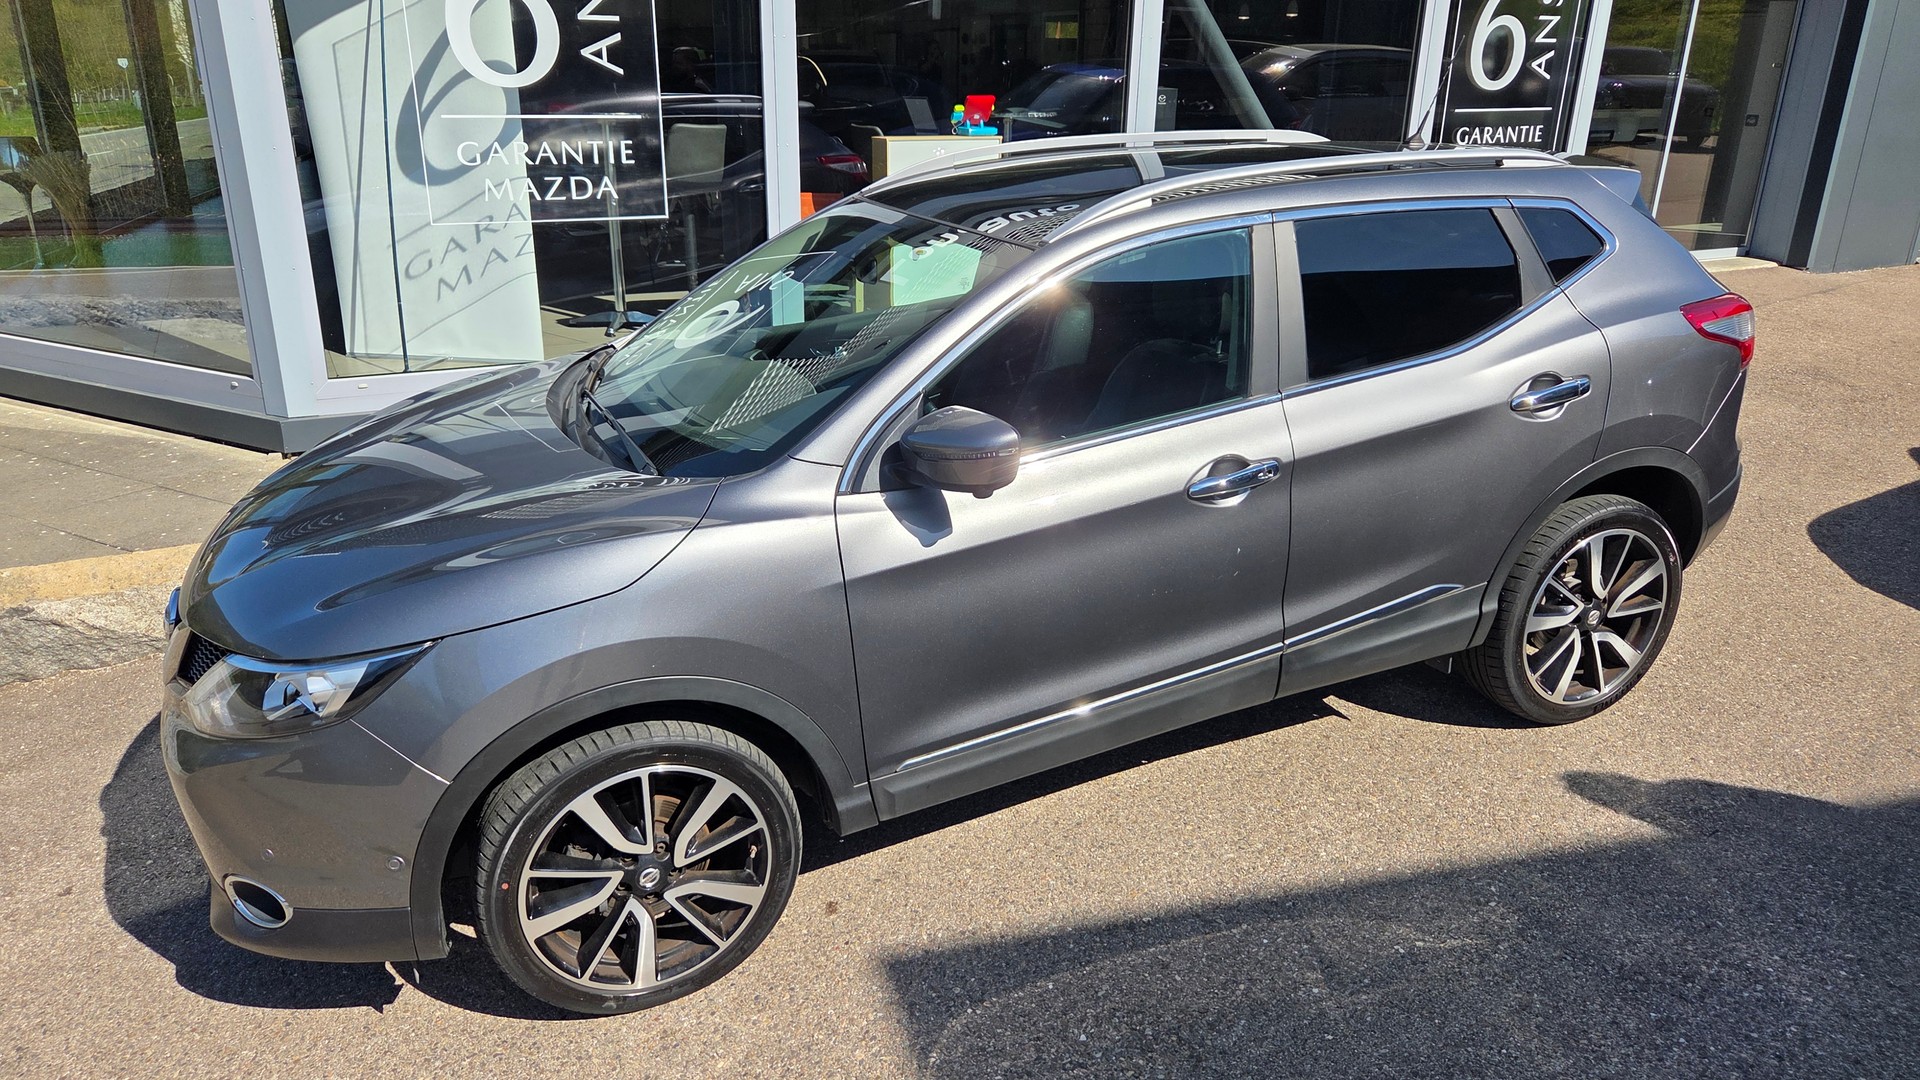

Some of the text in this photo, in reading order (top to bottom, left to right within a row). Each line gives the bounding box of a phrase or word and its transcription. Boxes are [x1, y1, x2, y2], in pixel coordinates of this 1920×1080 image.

[1470, 0, 1526, 91] 6
[1456, 124, 1544, 145] GARANTIE
[456, 140, 636, 166] GARANTIE
[484, 175, 619, 201] MAZDA
